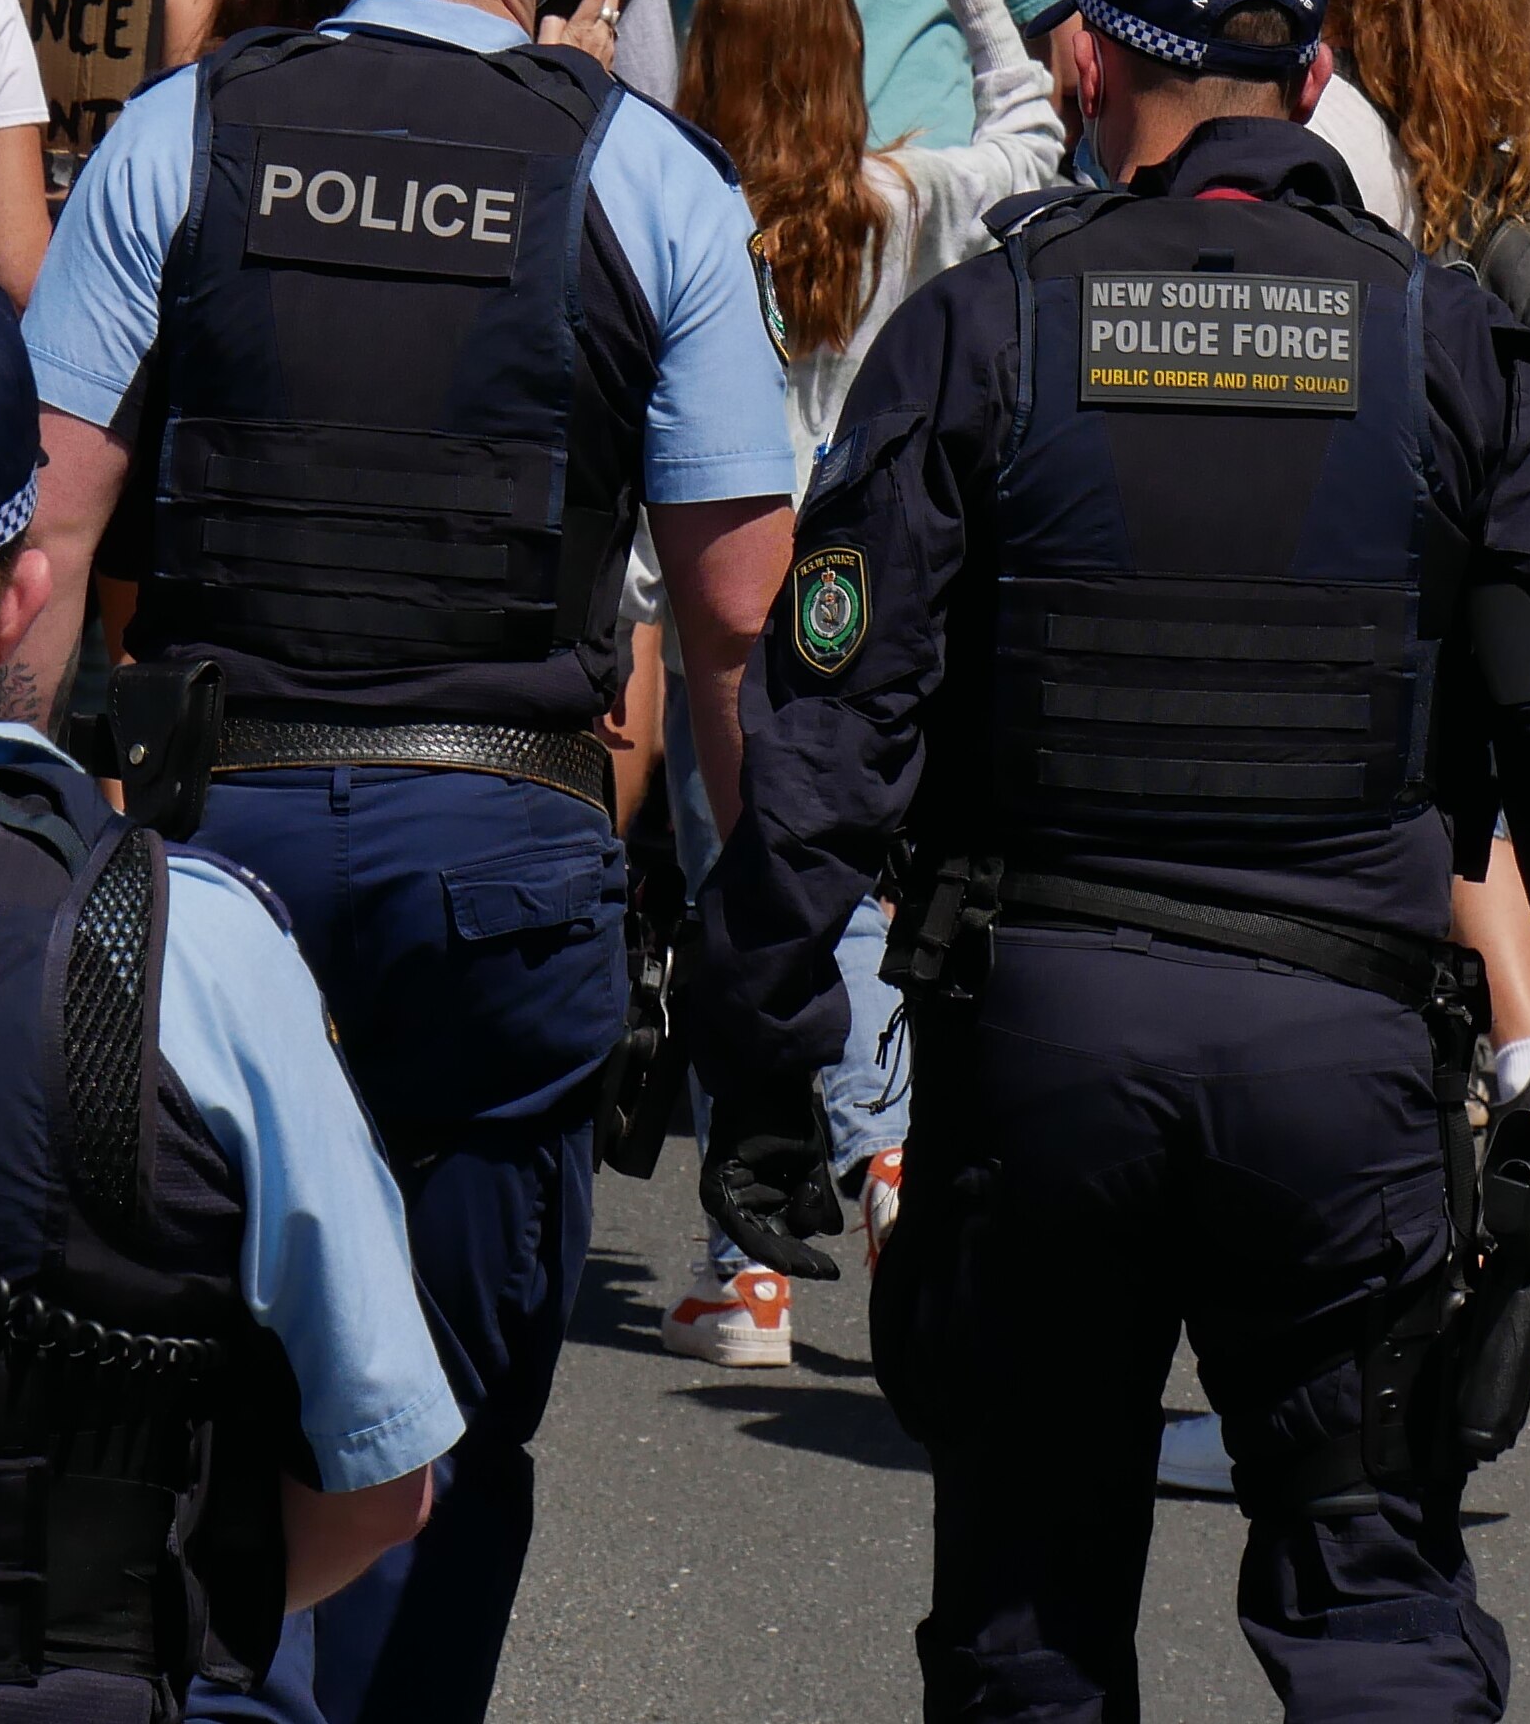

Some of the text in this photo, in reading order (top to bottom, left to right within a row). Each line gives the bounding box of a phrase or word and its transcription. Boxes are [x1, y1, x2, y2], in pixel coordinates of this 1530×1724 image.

[259, 164, 516, 244] POLICE
[1091, 282, 1351, 317] NEW SOUTH WALES
[1090, 319, 1350, 362] POLICE FORCE
[1090, 368, 1350, 395] PUBLIC ORDER AND RIOT SQUAD
[826, 554, 856, 567] POLICE
